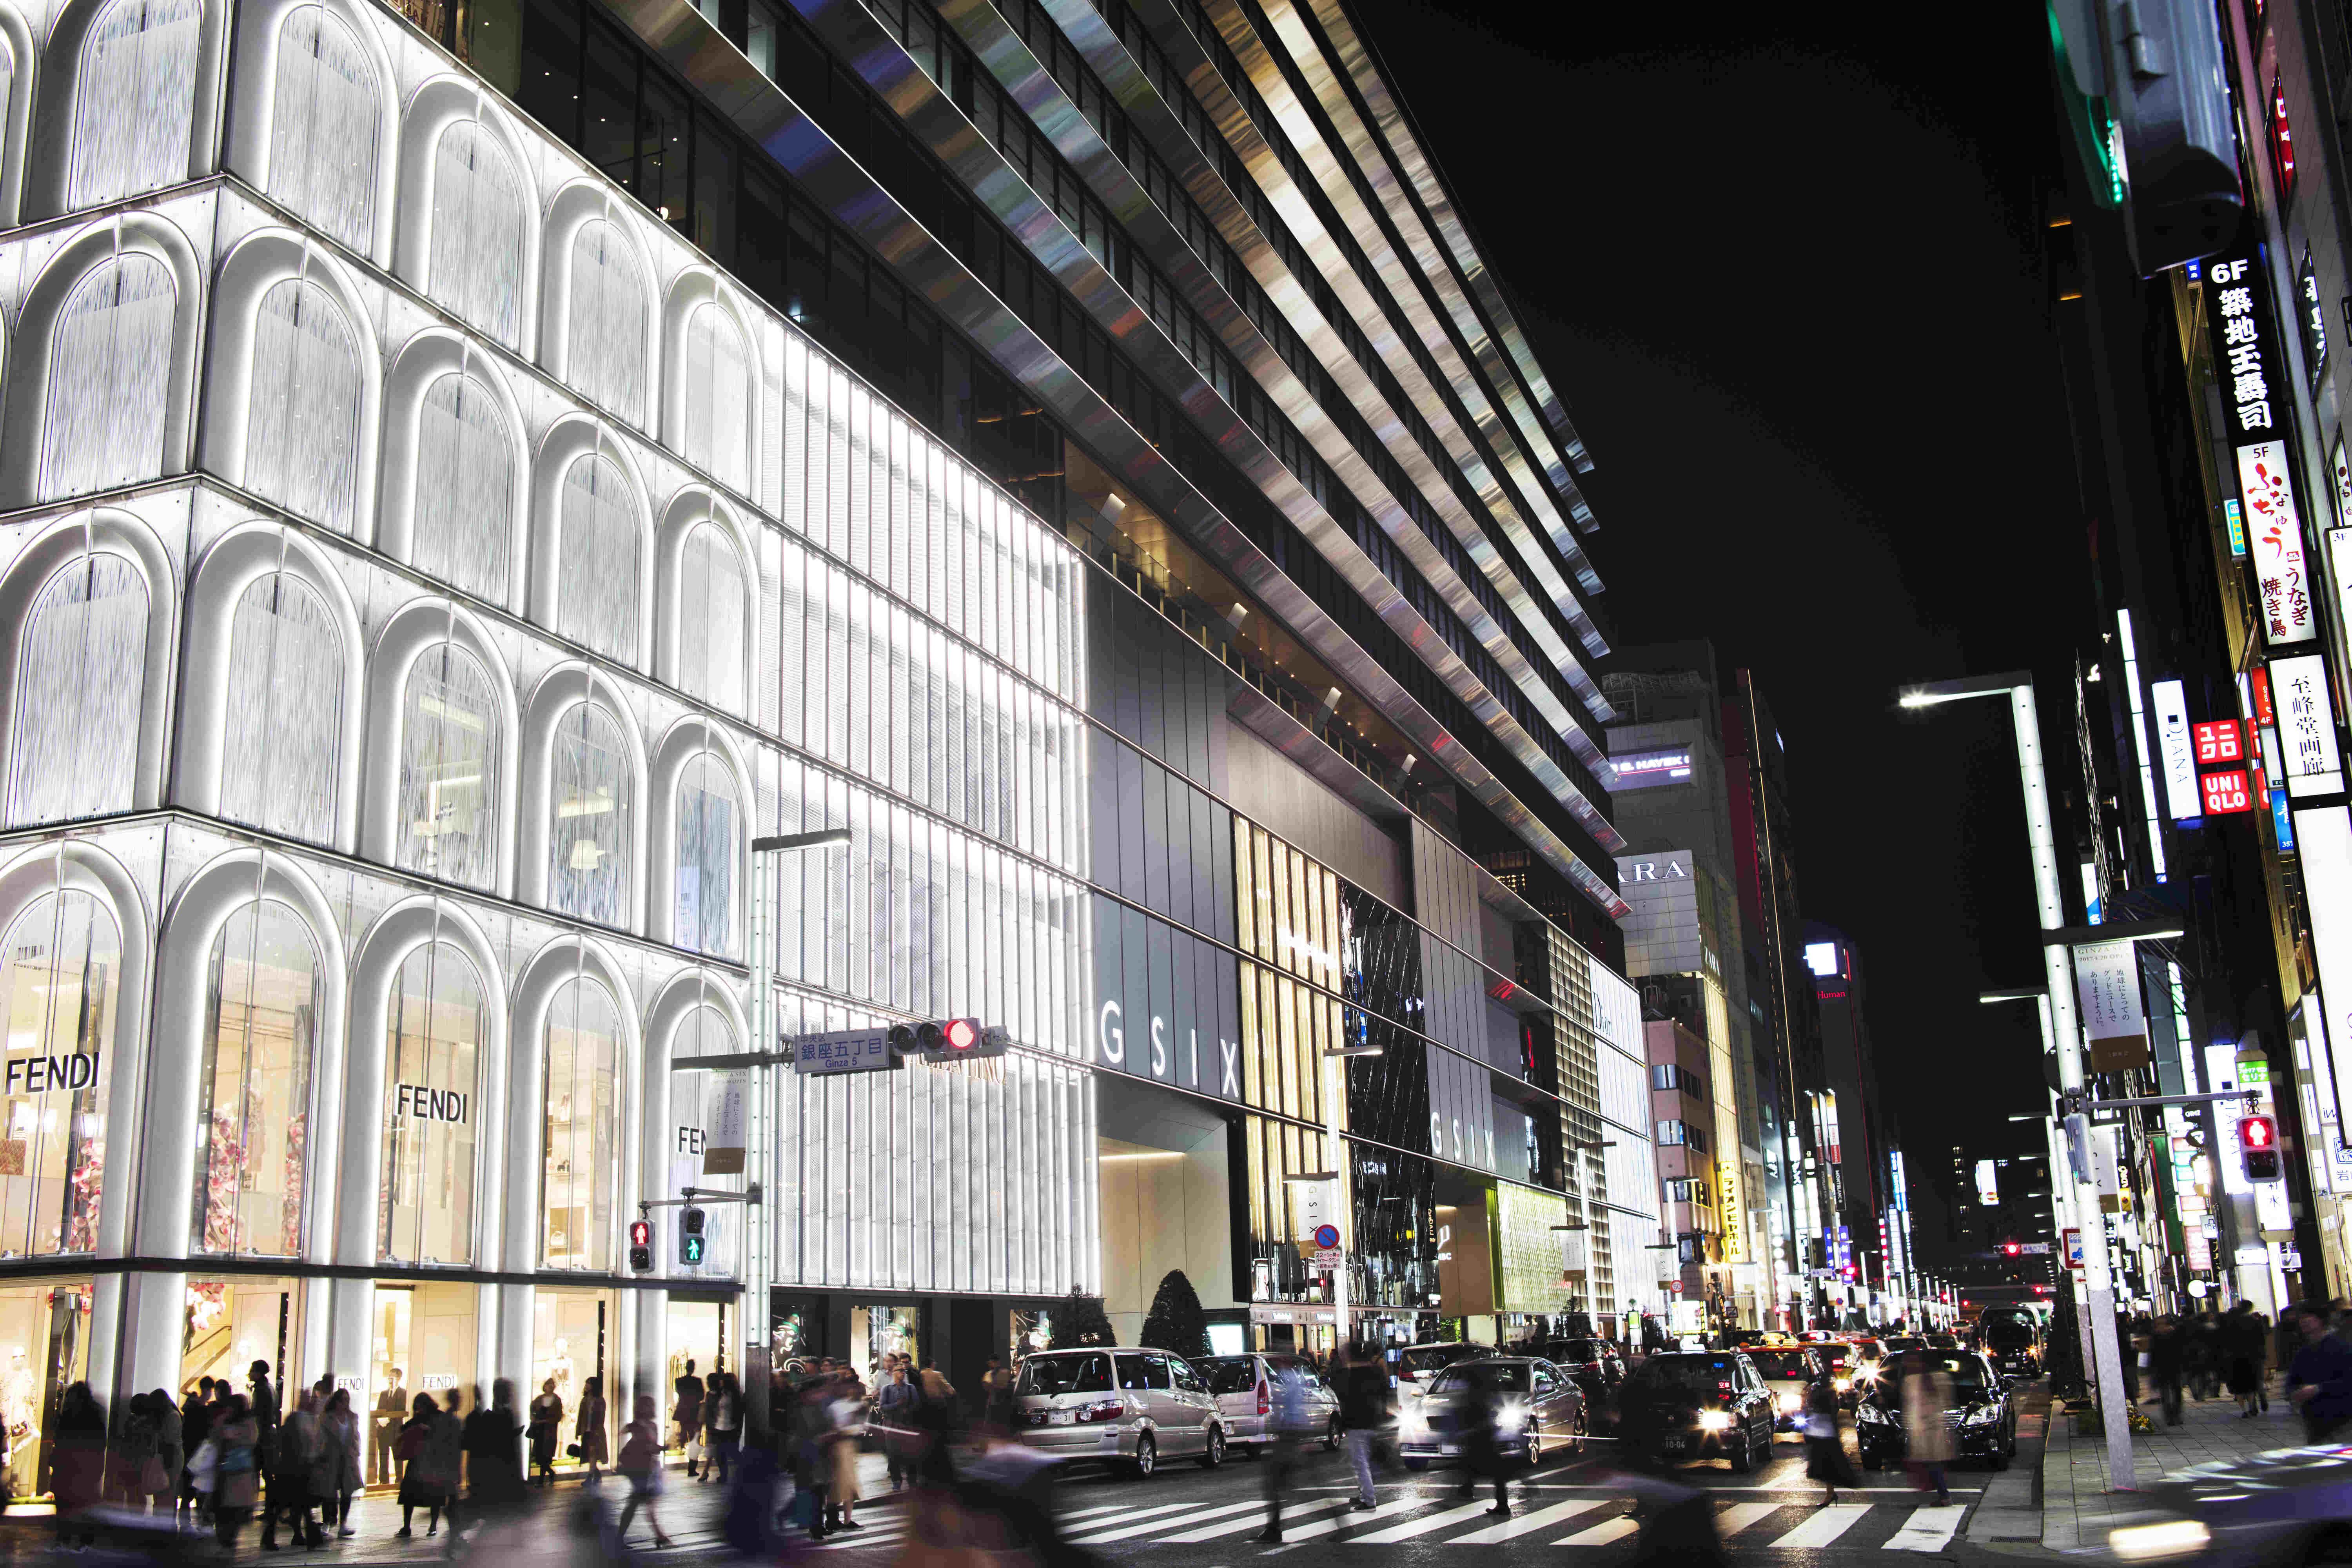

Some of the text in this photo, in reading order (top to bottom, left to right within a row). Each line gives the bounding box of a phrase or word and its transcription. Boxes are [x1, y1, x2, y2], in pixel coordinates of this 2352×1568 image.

[2211, 259, 2248, 283] 6F
[2253, 446, 2269, 459] 5F
[2286, 568, 2309, 626] うなぎ
[2262, 577, 2287, 637] 焼き鳥
[2260, 717, 2271, 725] 4F
[2291, 675, 2325, 777] 至峰堂画廊
[2200, 724, 2234, 742] ユニ
[2201, 742, 2237, 760] クロ
[2205, 776, 2240, 793] UNI
[2208, 791, 2246, 811] QLO
[1817, 991, 1846, 1000] Human
[2117, 969, 2130, 1020] 地球にとっての
[800, 1034, 826, 1043] 中央区
[801, 1038, 882, 1060] 銀座五丁目
[825, 1057, 858, 1069] Ginza 5
[5, 1051, 100, 1094] FENDI
[2242, 1073, 2267, 1082] セリナ
[397, 1083, 467, 1124] FENDI
[423, 1376, 455, 1388] FENDI
